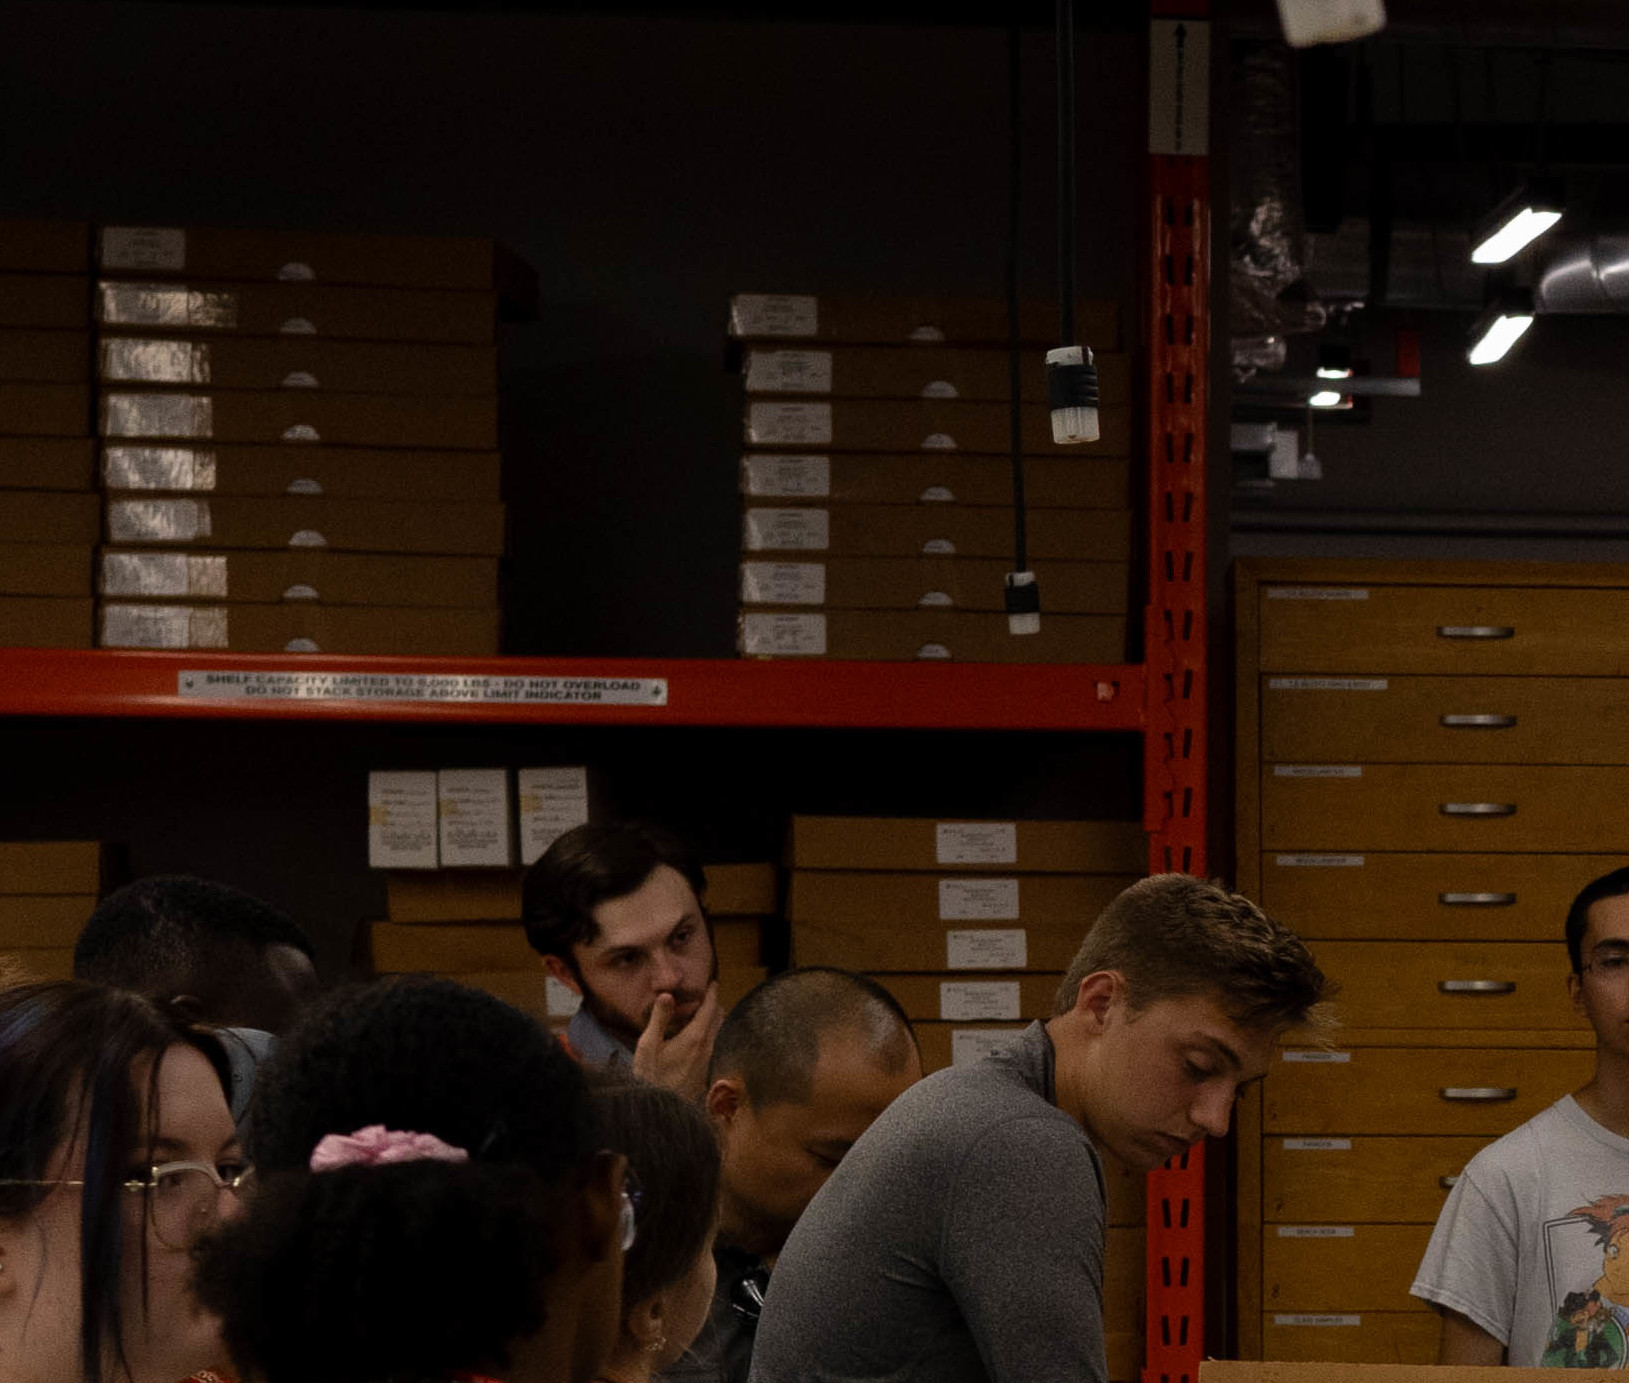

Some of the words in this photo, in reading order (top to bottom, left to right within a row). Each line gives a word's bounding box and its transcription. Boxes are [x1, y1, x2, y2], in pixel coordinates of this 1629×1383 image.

[206, 674, 251, 685] SHELF
[256, 675, 327, 686] CAPACITY
[332, 676, 390, 687] LIMITED
[395, 677, 417, 687] TO
[463, 678, 489, 688] LBS
[504, 678, 524, 689] DO
[529, 679, 557, 689] NOT
[562, 679, 641, 690] OVERLOAD
[245, 686, 267, 695] DO
[271, 686, 301, 695] NOT
[306, 687, 353, 696] STACK
[356, 688, 425, 698] STORAGE
[430, 689, 479, 698] ABOVE
[484, 689, 520, 699] LIMIT
